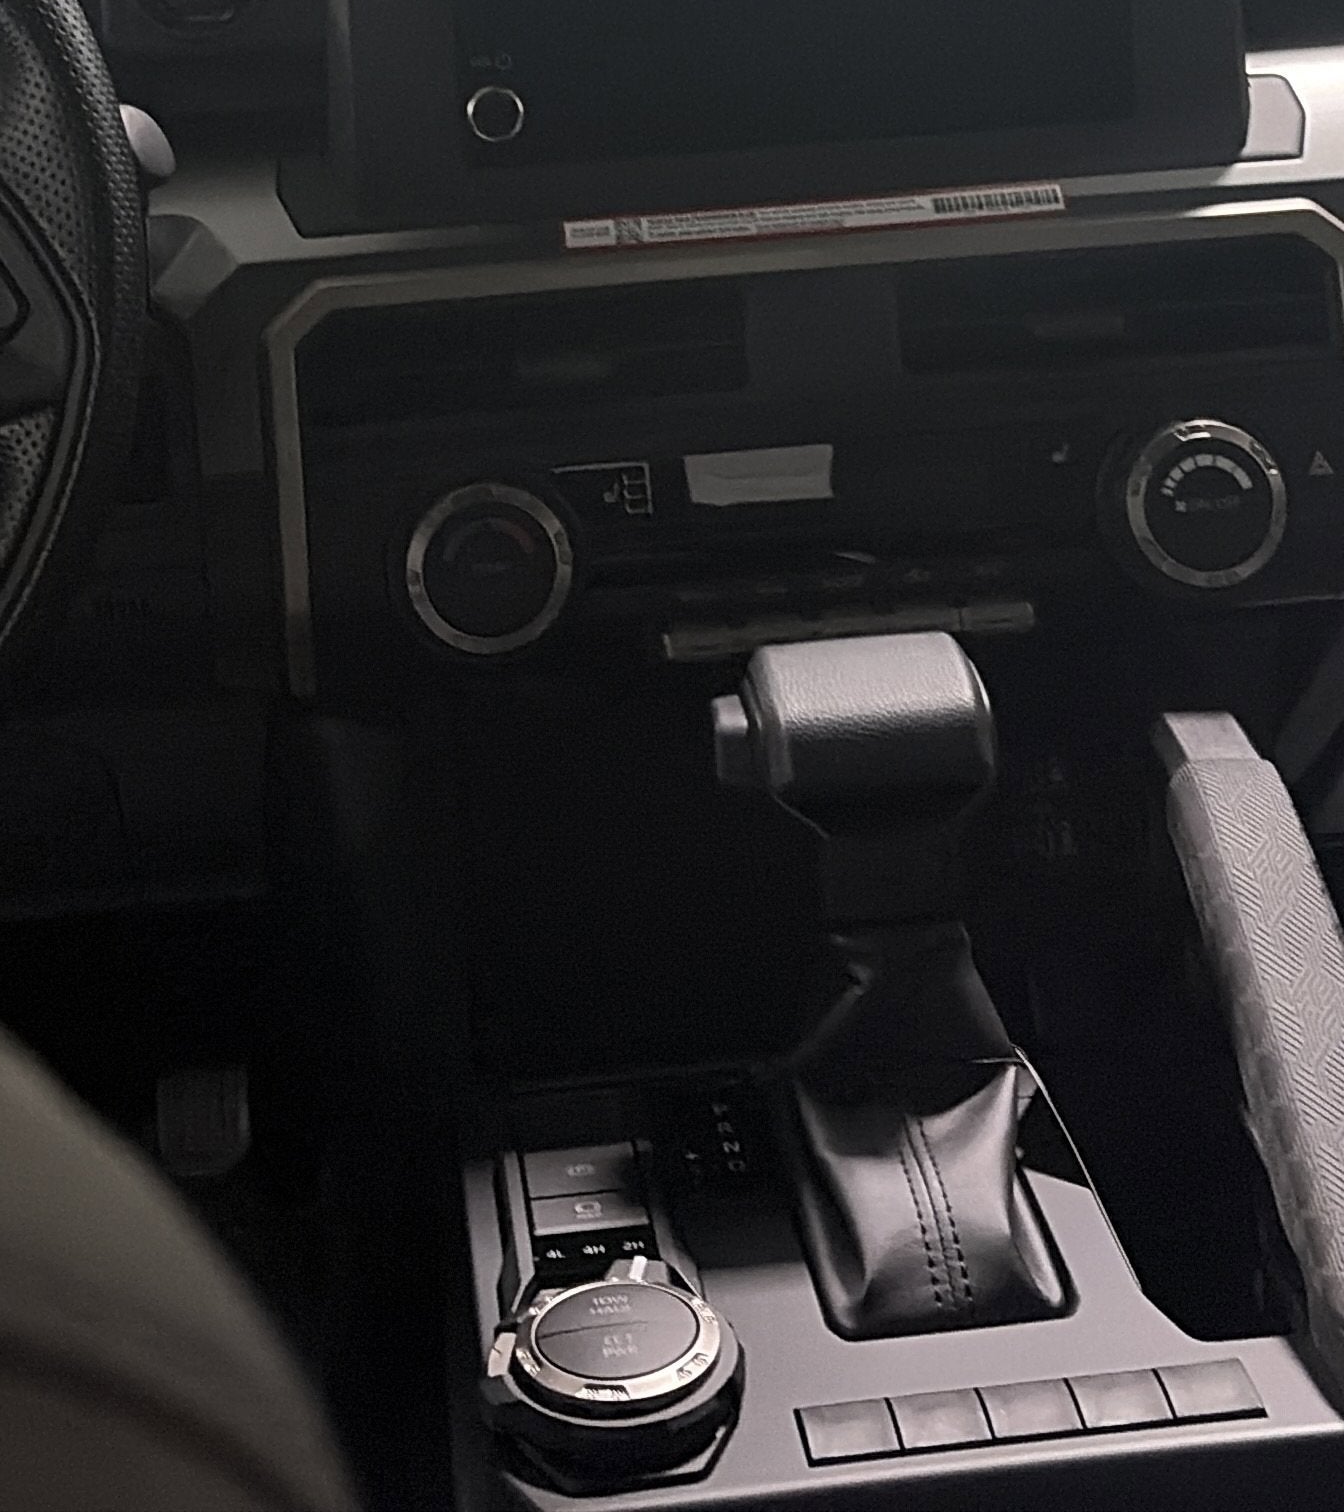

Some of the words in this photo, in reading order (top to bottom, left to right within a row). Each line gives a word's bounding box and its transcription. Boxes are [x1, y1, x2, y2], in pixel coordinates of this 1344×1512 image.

[722, 1139, 742, 1154] N
[581, 1243, 606, 1256] 4H
[621, 1240, 646, 1252] 2H
